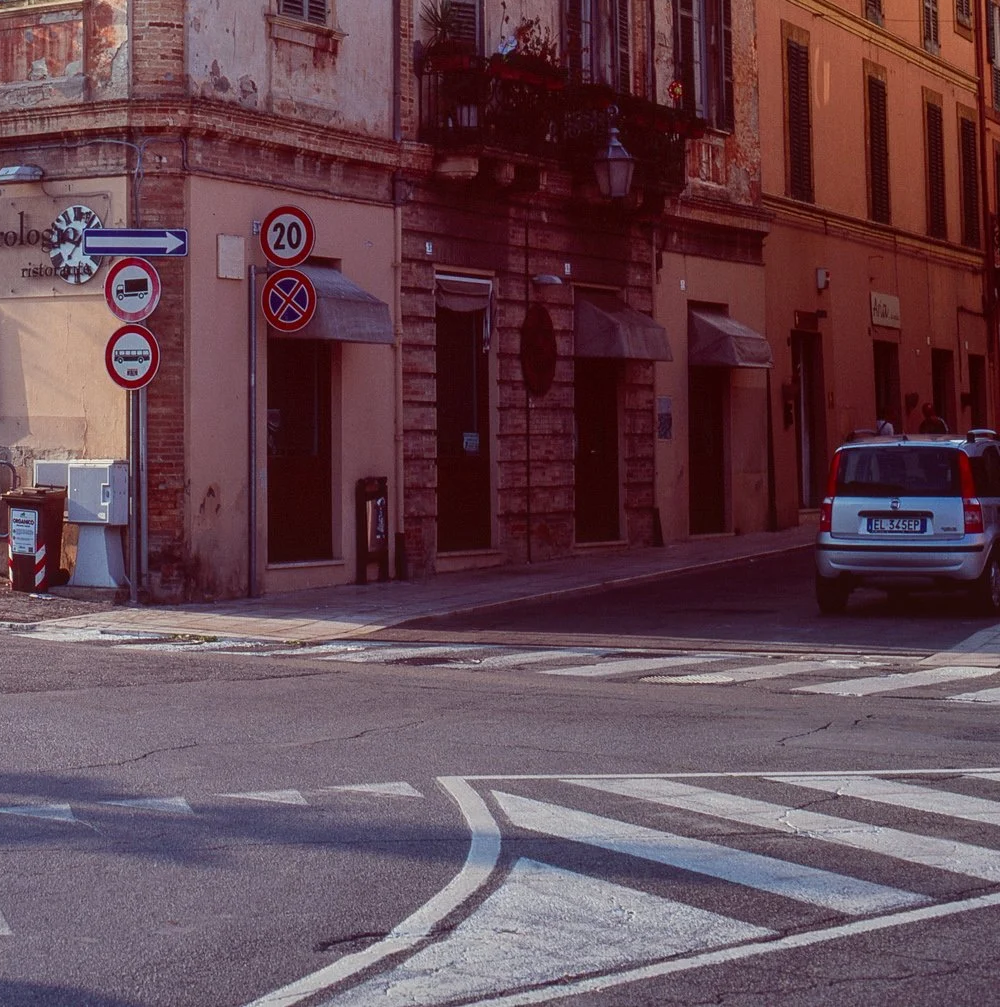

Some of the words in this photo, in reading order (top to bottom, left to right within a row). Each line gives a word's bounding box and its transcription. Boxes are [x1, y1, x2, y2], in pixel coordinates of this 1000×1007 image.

[273, 221, 302, 250] 20
[21, 261, 92, 278] ristorante
[874, 519, 885, 530] EL
[889, 519, 920, 530] 345EP
